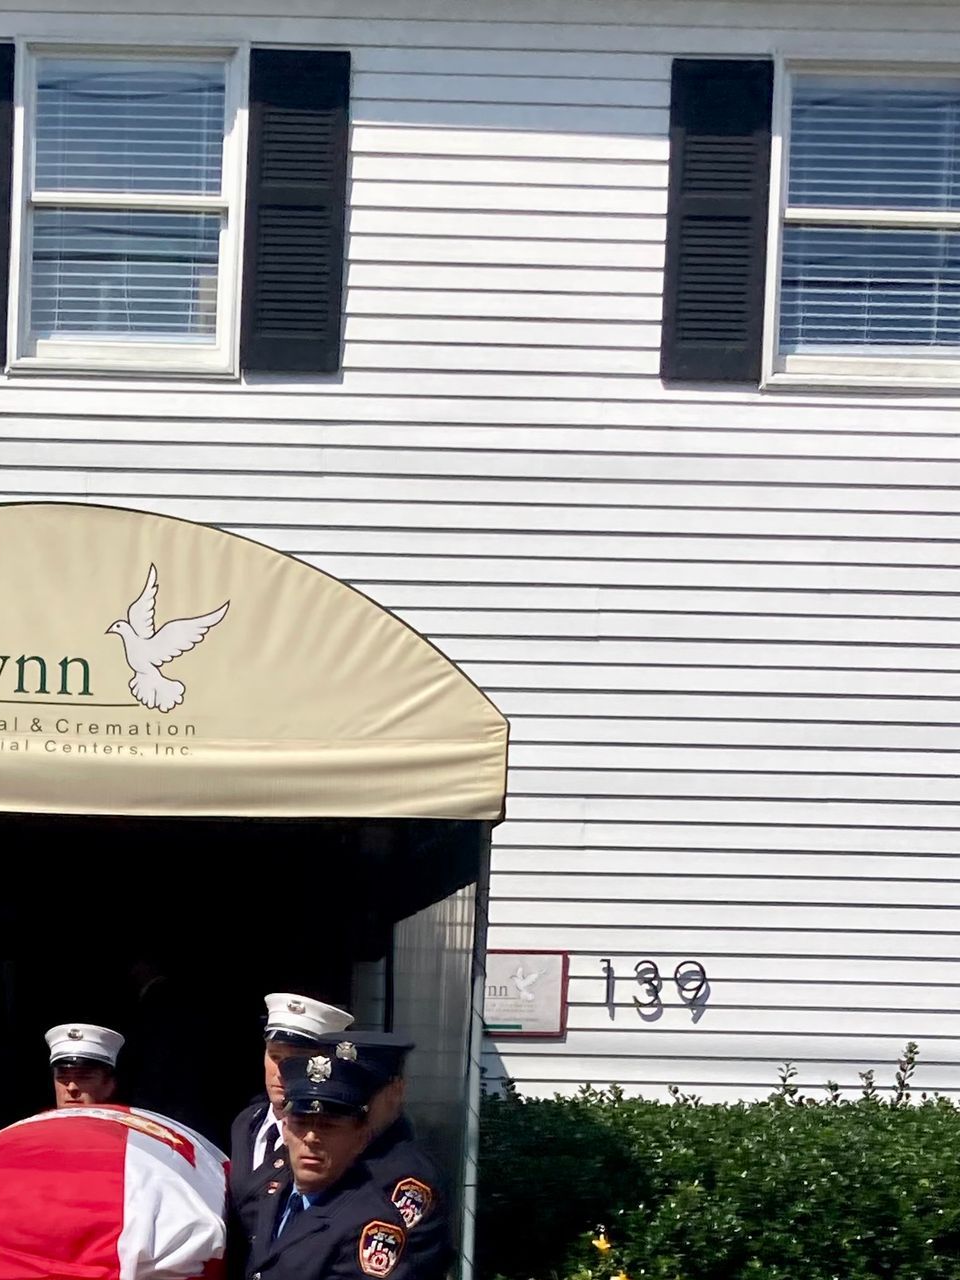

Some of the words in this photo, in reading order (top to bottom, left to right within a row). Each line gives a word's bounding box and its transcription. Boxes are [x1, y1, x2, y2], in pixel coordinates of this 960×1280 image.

[30, 717, 43, 732] &
[55, 718, 196, 736] Cremation
[600, 958, 707, 1007] 139
